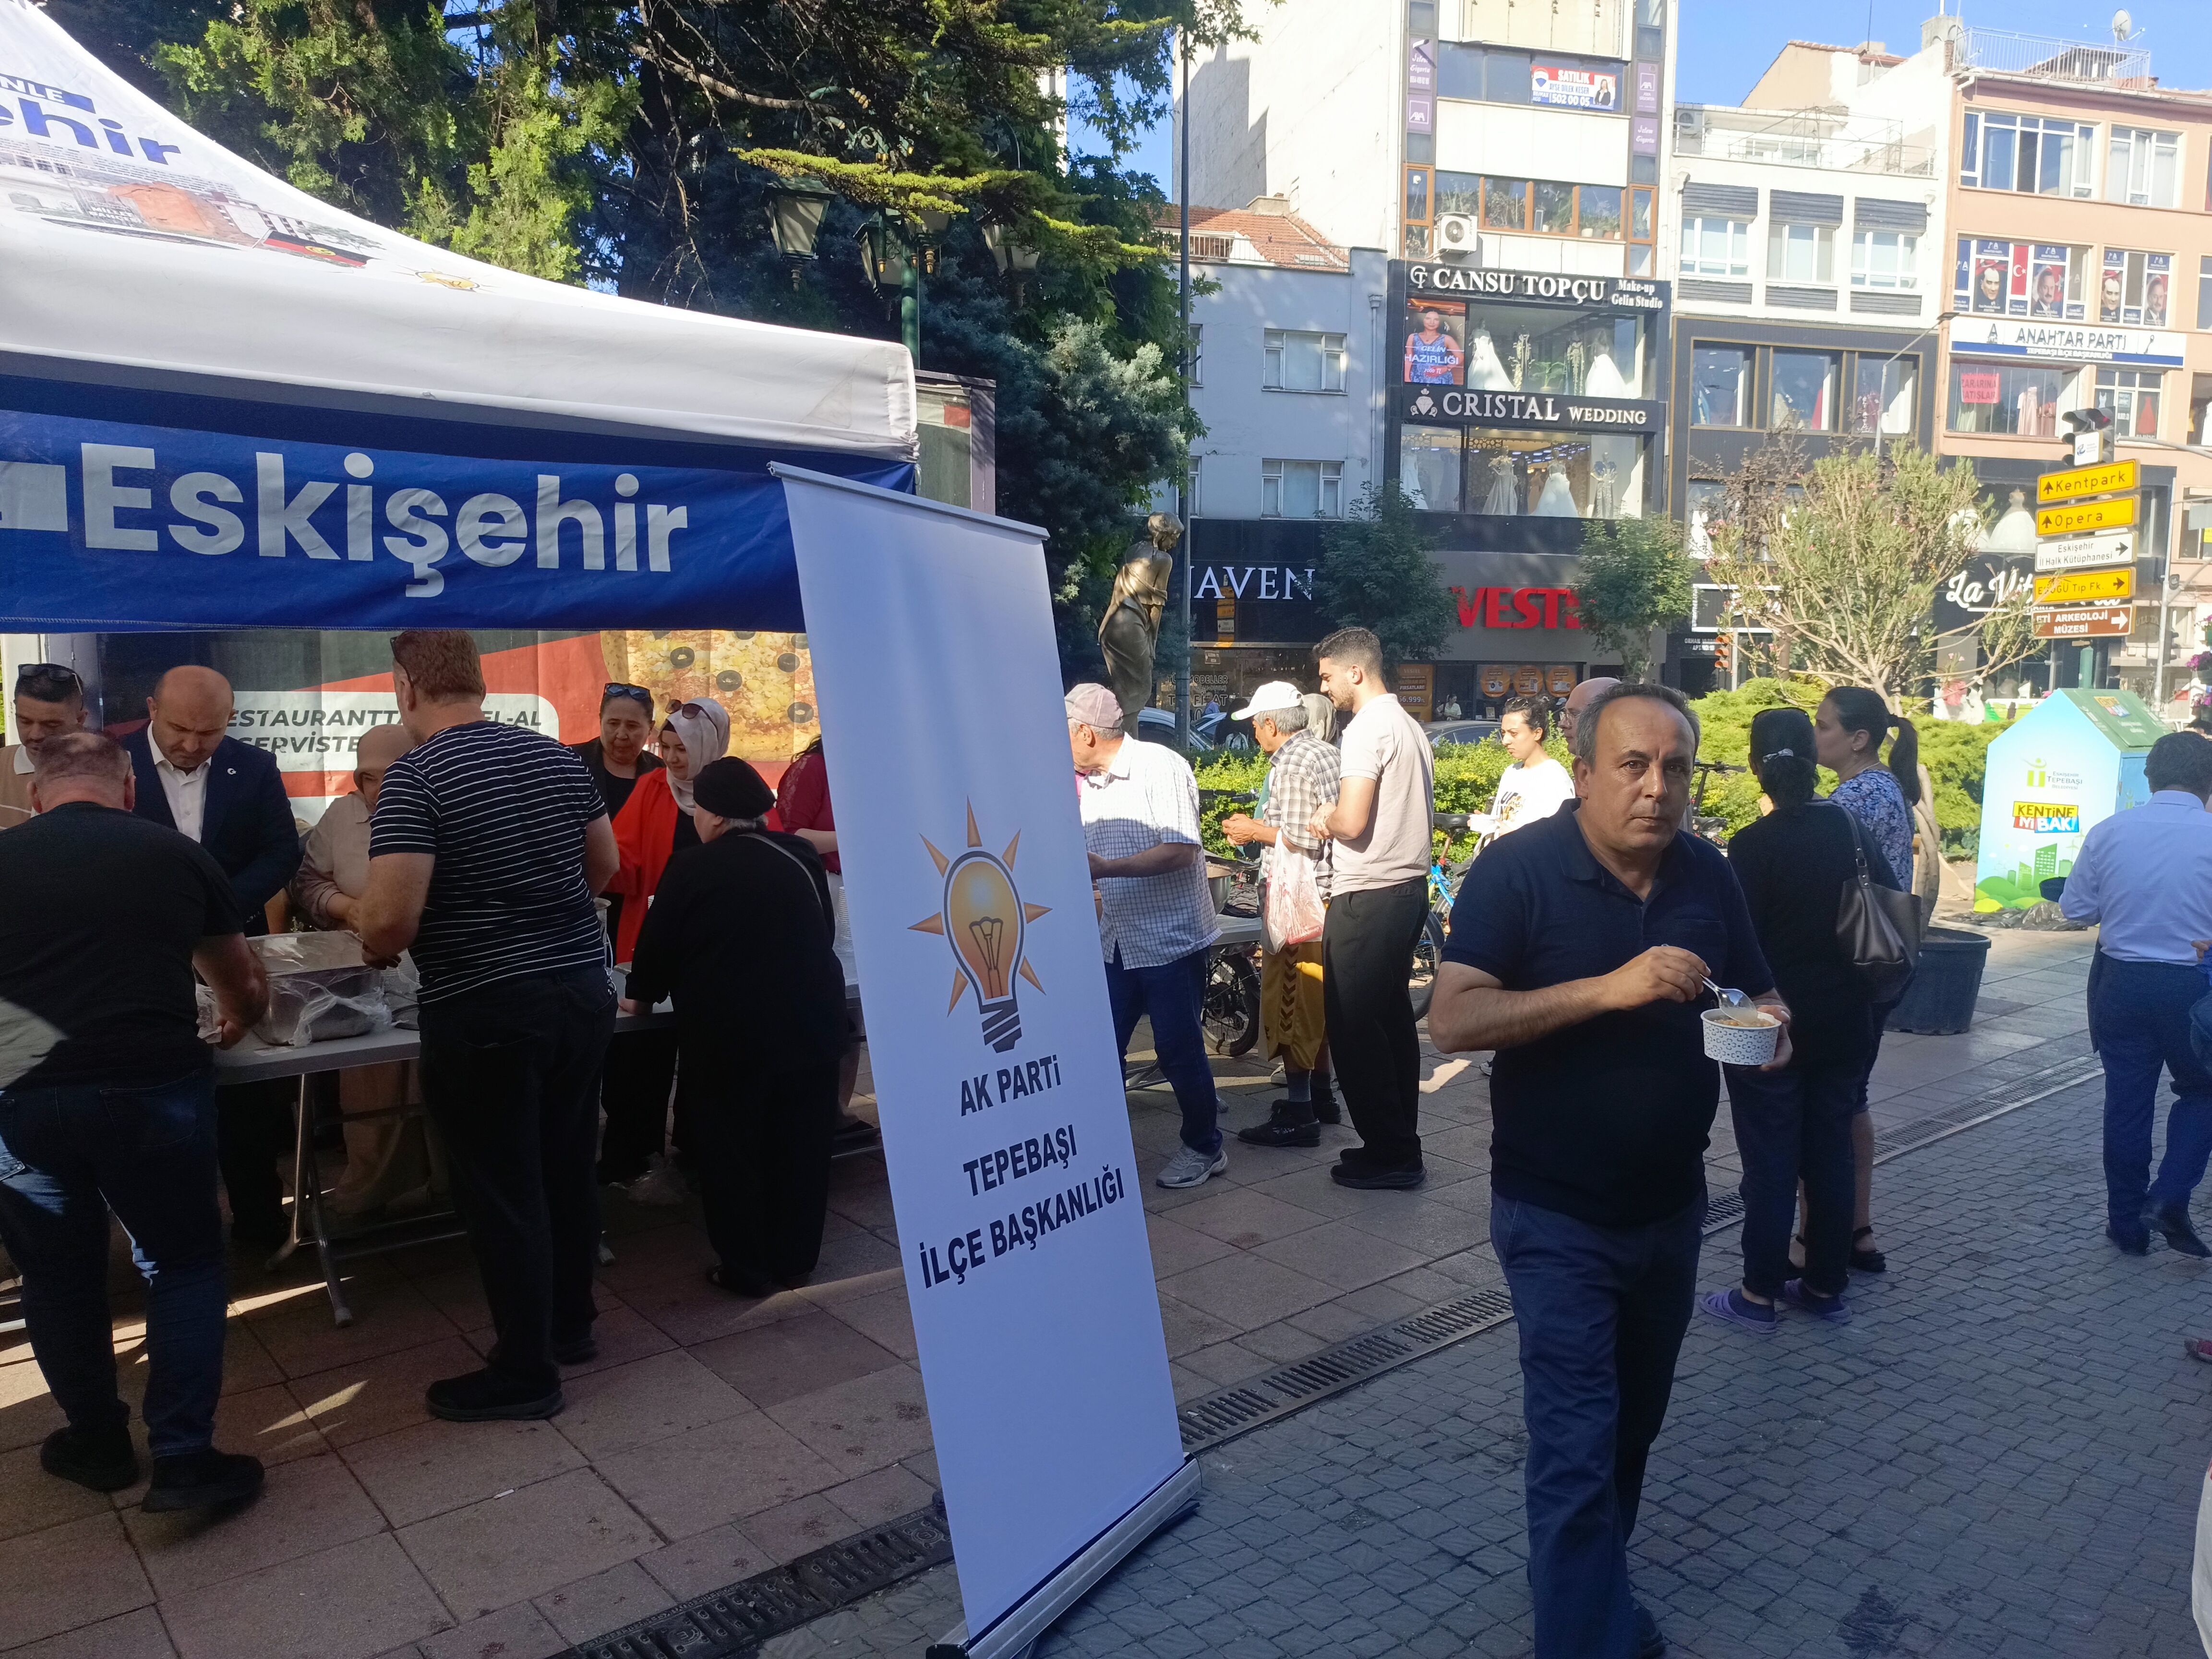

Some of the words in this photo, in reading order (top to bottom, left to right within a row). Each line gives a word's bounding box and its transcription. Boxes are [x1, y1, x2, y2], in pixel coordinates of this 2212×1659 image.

[1558, 70, 1590, 84] SATILIK
[1562, 84, 1574, 93] DİLEK
[1568, 96, 1578, 106] 00
[1580, 97, 1590, 107] 05
[1410, 111, 1425, 121] AXA
[1433, 268, 1515, 294] CANSU
[1523, 275, 1607, 304] TOPÇU
[1618, 279, 1656, 296] Make-up
[1611, 293, 1635, 306] Gelin
[1635, 295, 1663, 309] Studio
[2015, 327, 2084, 347] ANAHTAR
[2088, 333, 2127, 350] PARTİ
[1405, 354, 1459, 365] HAZIRLIĞI
[2026, 347, 2057, 357] TEPEBAŞI
[1443, 392, 1561, 421] CRISTAL
[1567, 405, 1647, 425] WEDDING
[2056, 470, 2126, 493] Kentpark
[81, 442, 687, 598] Eskişehir
[2055, 512, 2103, 529] Opera
[2058, 542, 2093, 553] Eskişehir
[2045, 558, 2062, 566] Halk
[2064, 551, 2113, 564] Kütüphanesi
[1946, 570, 1984, 608] La
[2072, 583, 2086, 594] Tıp
[2090, 582, 2104, 591] Fk.
[2036, 613, 2051, 623] ETİ
[2055, 610, 2108, 622] ARKEOLOJİ
[2054, 623, 2088, 634] MÜZESİ
[1193, 691, 1228, 706] FİAT
[482, 710, 541, 726] EL-AL
[2047, 776, 2082, 786] TEPEBAŞI
[2037, 817, 2076, 831] BAK!
[961, 1073, 994, 1117] AK
[997, 1054, 1061, 1104] PARTİ
[963, 1124, 1078, 1197] TEPEBAŞI
[919, 1228, 986, 1289] İLÇE
[989, 1164, 1125, 1258] BAŞKANLIĞI
